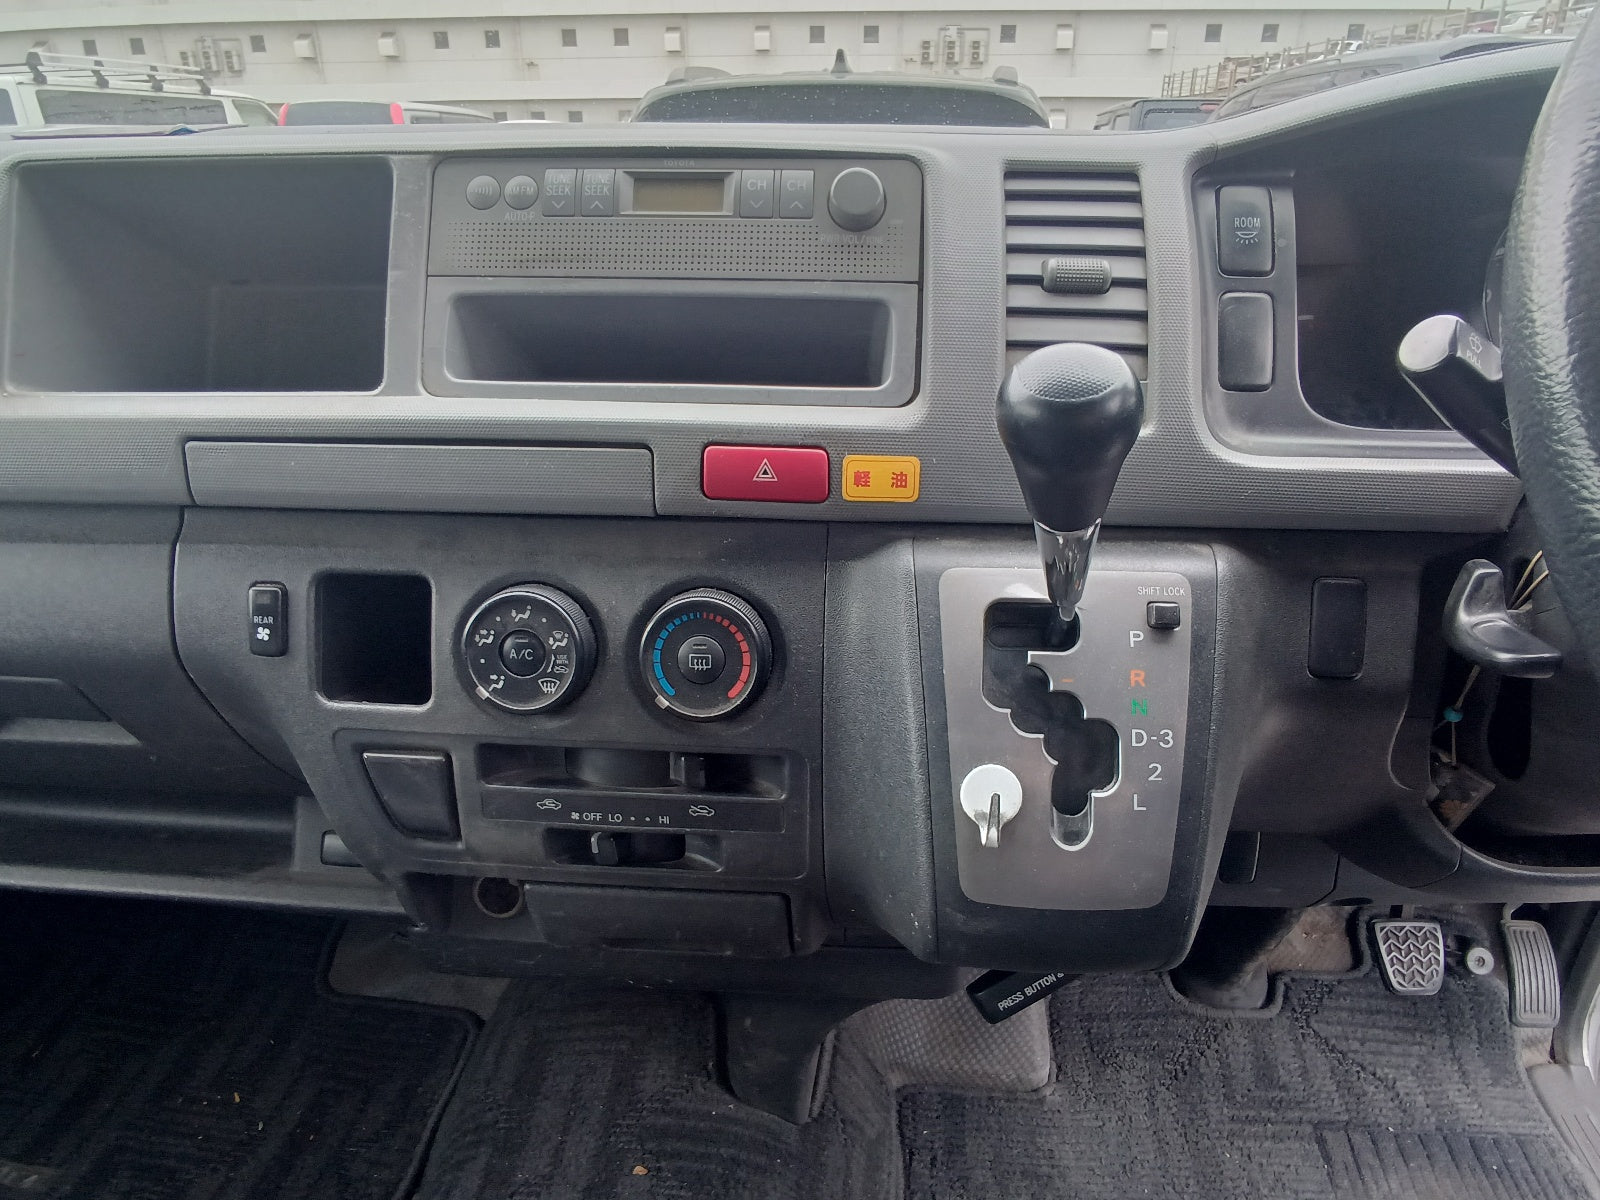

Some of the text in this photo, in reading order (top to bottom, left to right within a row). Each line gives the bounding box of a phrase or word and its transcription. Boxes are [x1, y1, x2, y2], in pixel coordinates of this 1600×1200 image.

[663, 159, 696, 167] TOYOTA
[547, 173, 572, 184] TUNE
[586, 173, 611, 184] TUNE
[546, 184, 571, 196] SEEK
[584, 184, 610, 196] SEEK
[747, 179, 767, 191] CH
[786, 180, 807, 191] CH
[1234, 217, 1261, 228] ROOM
[1137, 585, 1186, 596] SHIFT LOCK
[253, 615, 274, 625] REAR
[1129, 630, 1144, 648] P
[509, 648, 534, 660] A/C
[1129, 669, 1146, 688] R
[1131, 698, 1148, 717] N
[1148, 762, 1163, 781] 2
[1133, 793, 1147, 811] L
[582, 812, 670, 825] OFF LO HI
[997, 991, 1025, 1012] PRESS
[1024, 973, 1057, 997] BUTTON
